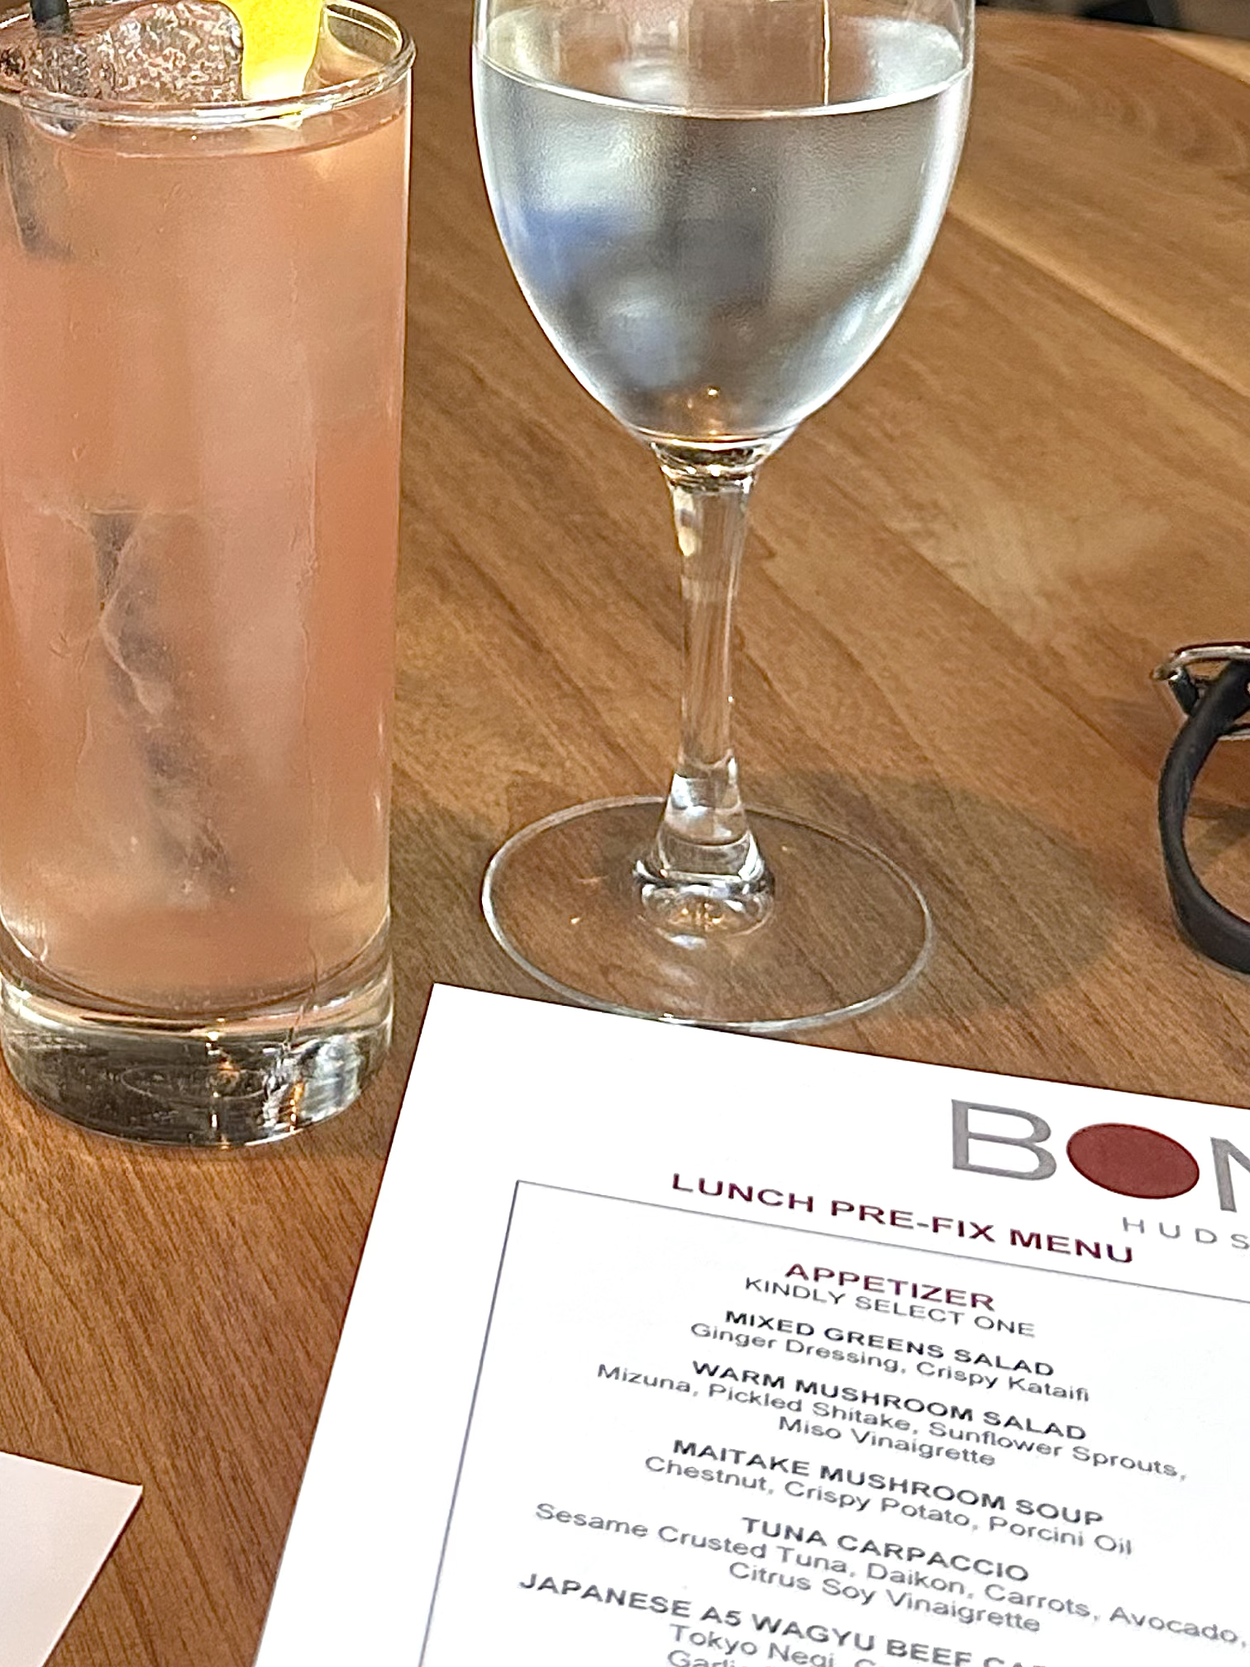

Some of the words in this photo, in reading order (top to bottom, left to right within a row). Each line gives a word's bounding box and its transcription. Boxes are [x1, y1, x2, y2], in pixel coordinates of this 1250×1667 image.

[672, 1173, 815, 1213] LUNCH
[830, 1200, 996, 1243] PRE-FIX
[1010, 1228, 1133, 1264] MENU
[745, 1277, 846, 1305] KINDLY
[854, 1295, 966, 1326] SELECT
[974, 1315, 1036, 1338] ONE
[784, 1263, 996, 1312] APPETIZER
[690, 1322, 778, 1351] Ginger
[785, 1339, 907, 1374] Dressing,
[916, 1361, 998, 1390] Crispy
[1008, 1376, 1090, 1402] Kataifi
[725, 1310, 815, 1338] MIXED
[823, 1326, 945, 1360] GREENS
[954, 1348, 1055, 1377] SALAD
[597, 1363, 699, 1397] Mizuna,
[708, 1383, 803, 1413] Pickled
[812, 1401, 919, 1435] Shitake,
[928, 1421, 1063, 1457] Sunflower
[1072, 1445, 1187, 1482] Sprouts,
[692, 1360, 785, 1390] WARM
[795, 1379, 974, 1422] MUSHROOM
[983, 1411, 1087, 1440] SALAD
[779, 1415, 843, 1440] Miso
[851, 1427, 996, 1466] Vinaigrette
[645, 1455, 775, 1496] Chestnut,
[784, 1480, 871, 1513] Crispy
[880, 1497, 979, 1533] Potato,
[988, 1516, 1085, 1547] Porcini
[1094, 1534, 1133, 1556] Oil
[672, 1439, 811, 1477] MAITAKE
[819, 1465, 1006, 1511] MUSHROOM
[1015, 1498, 1104, 1525] SOUP
[535, 1502, 649, 1539] Sesame
[657, 1525, 767, 1560] Crusted
[776, 1545, 856, 1578] Tuna,
[865, 1562, 975, 1600] Daikon,
[984, 1583, 1101, 1623] Carrots,
[1109, 1606, 1248, 1649] Avocado,
[741, 1517, 828, 1547] TUNA
[836, 1534, 1030, 1582] CARPACCIO
[517, 1573, 693, 1619] JAPANESE
[699, 1605, 743, 1628] A5
[751, 1613, 875, 1653] WAGYU
[886, 1638, 972, 1667] BEEF
[728, 1561, 812, 1592] Citrus
[821, 1578, 877, 1606] Soy
[885, 1588, 1041, 1634] Vinaigrette
[668, 1623, 759, 1656] Tokyo
